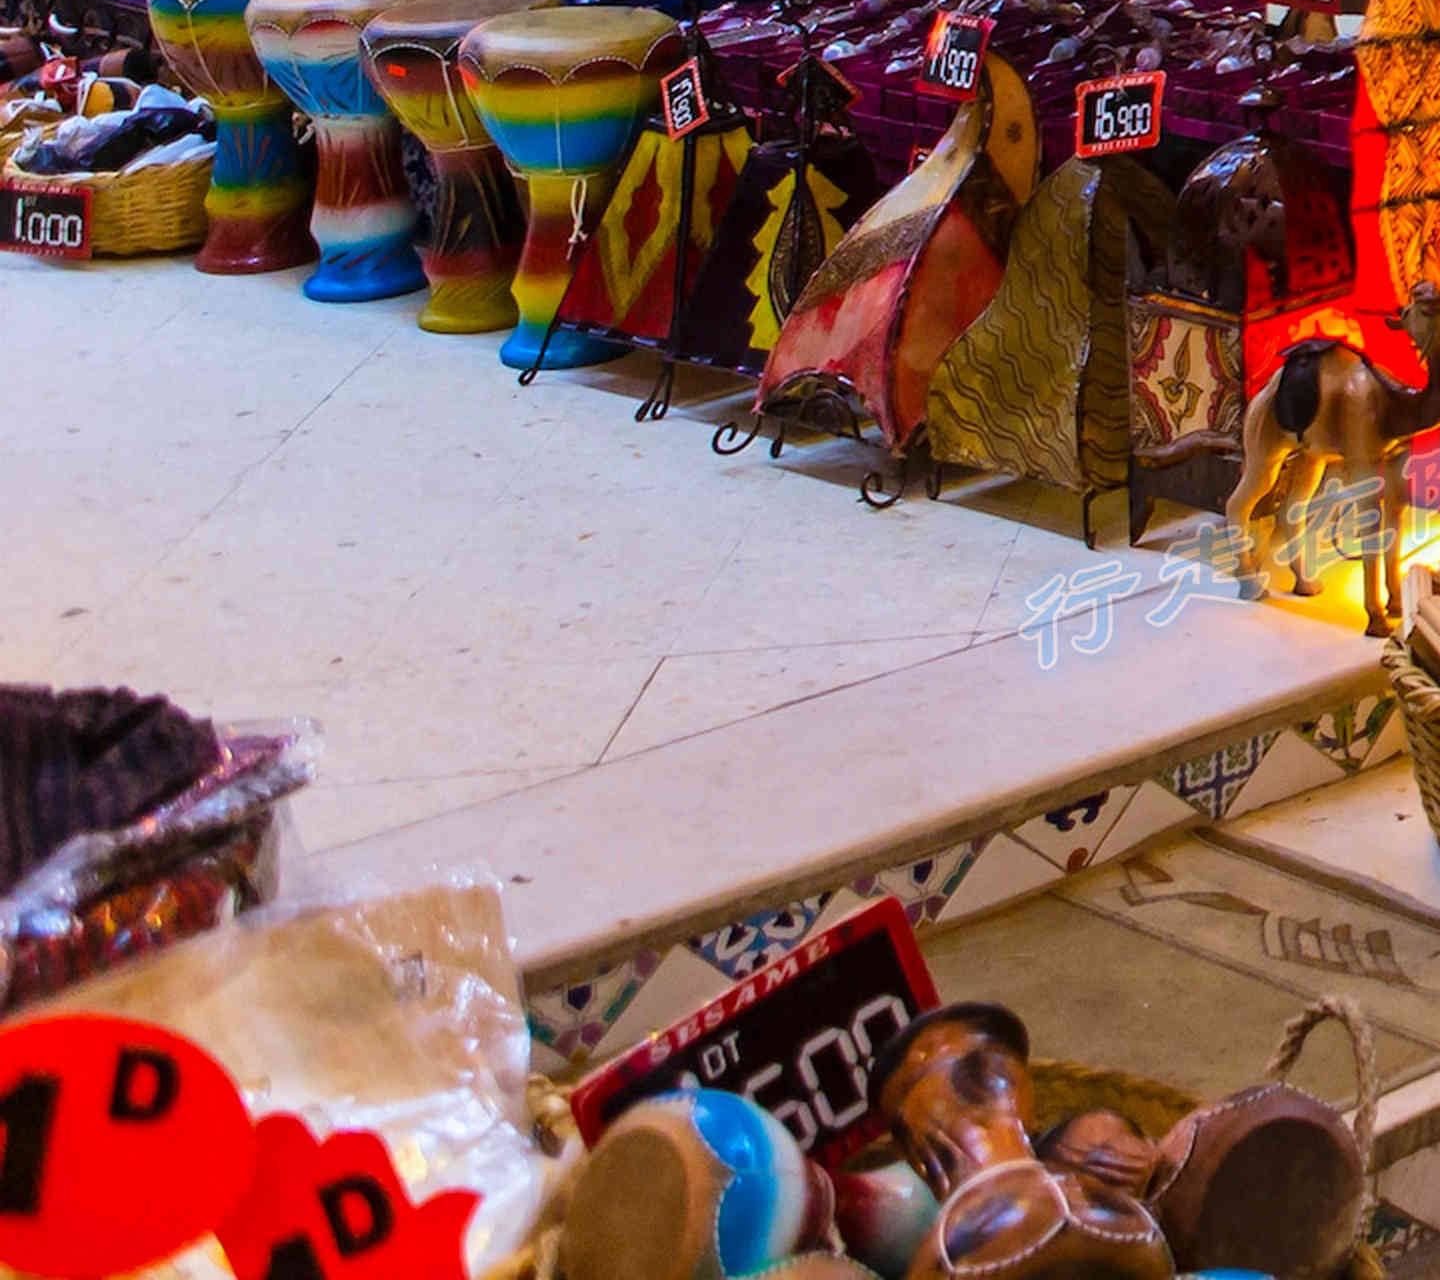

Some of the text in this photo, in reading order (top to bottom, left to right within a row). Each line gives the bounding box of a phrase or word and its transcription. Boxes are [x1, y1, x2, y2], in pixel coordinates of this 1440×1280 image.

[15, 197, 82, 248] 1.000
[649, 931, 832, 1062] SESAME
[109, 1045, 182, 1128] D
[701, 1030, 741, 1081] DT
[315, 1171, 394, 1259] D
